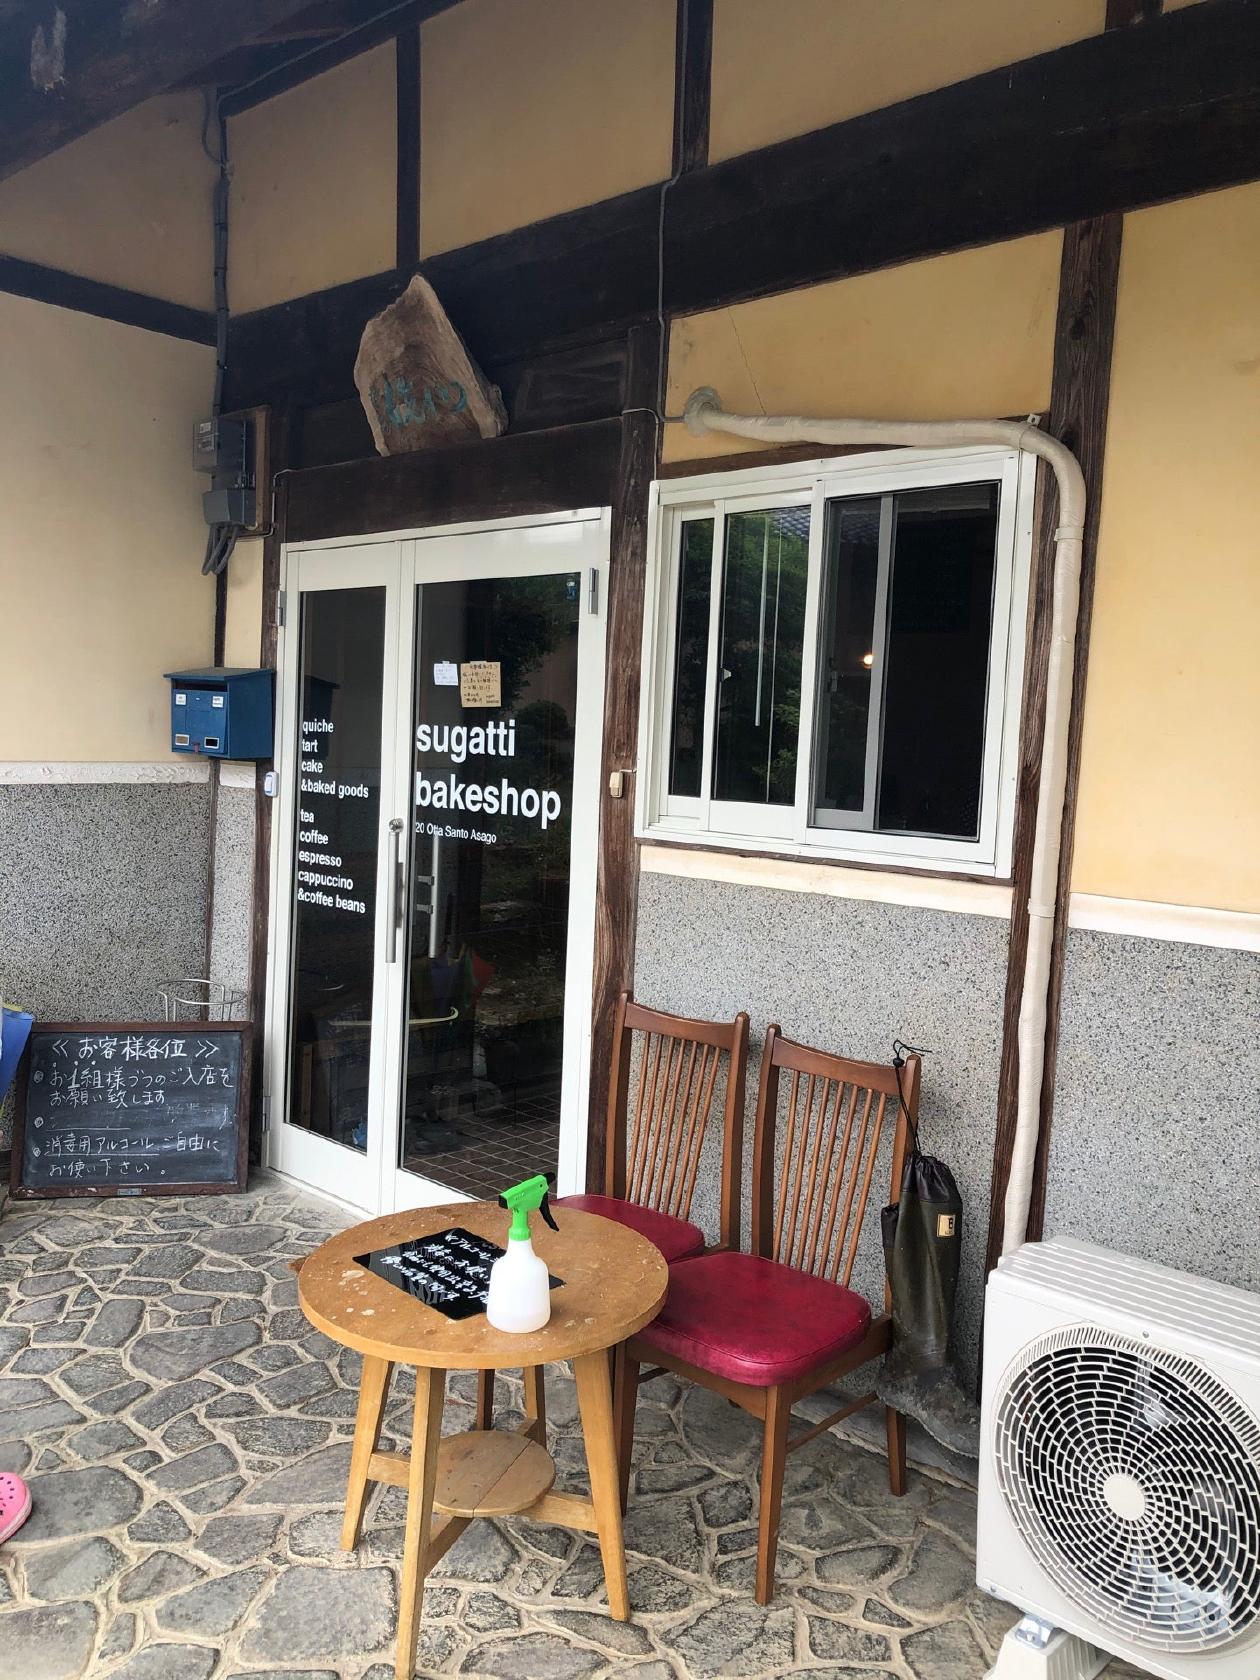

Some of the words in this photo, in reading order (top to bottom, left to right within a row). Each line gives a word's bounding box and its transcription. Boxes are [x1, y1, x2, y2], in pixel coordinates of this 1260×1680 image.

[302, 719, 334, 733] quiche
[302, 739, 318, 753] tart
[416, 719, 516, 763] sugatti
[301, 759, 323, 774] cake
[301, 779, 335, 796] &baked
[338, 784, 369, 799] goods
[415, 772, 561, 829] bakeshop
[300, 809, 314, 823] tea
[300, 830, 329, 845] coffee
[445, 825, 469, 839] Santo
[470, 829, 497, 845] Asago
[299, 851, 342, 868] espresso
[298, 870, 354, 890] cappuccino
[297, 887, 334, 907] &coffee
[335, 895, 366, 914] beans
[49, 1088, 166, 1108] お願い致します
